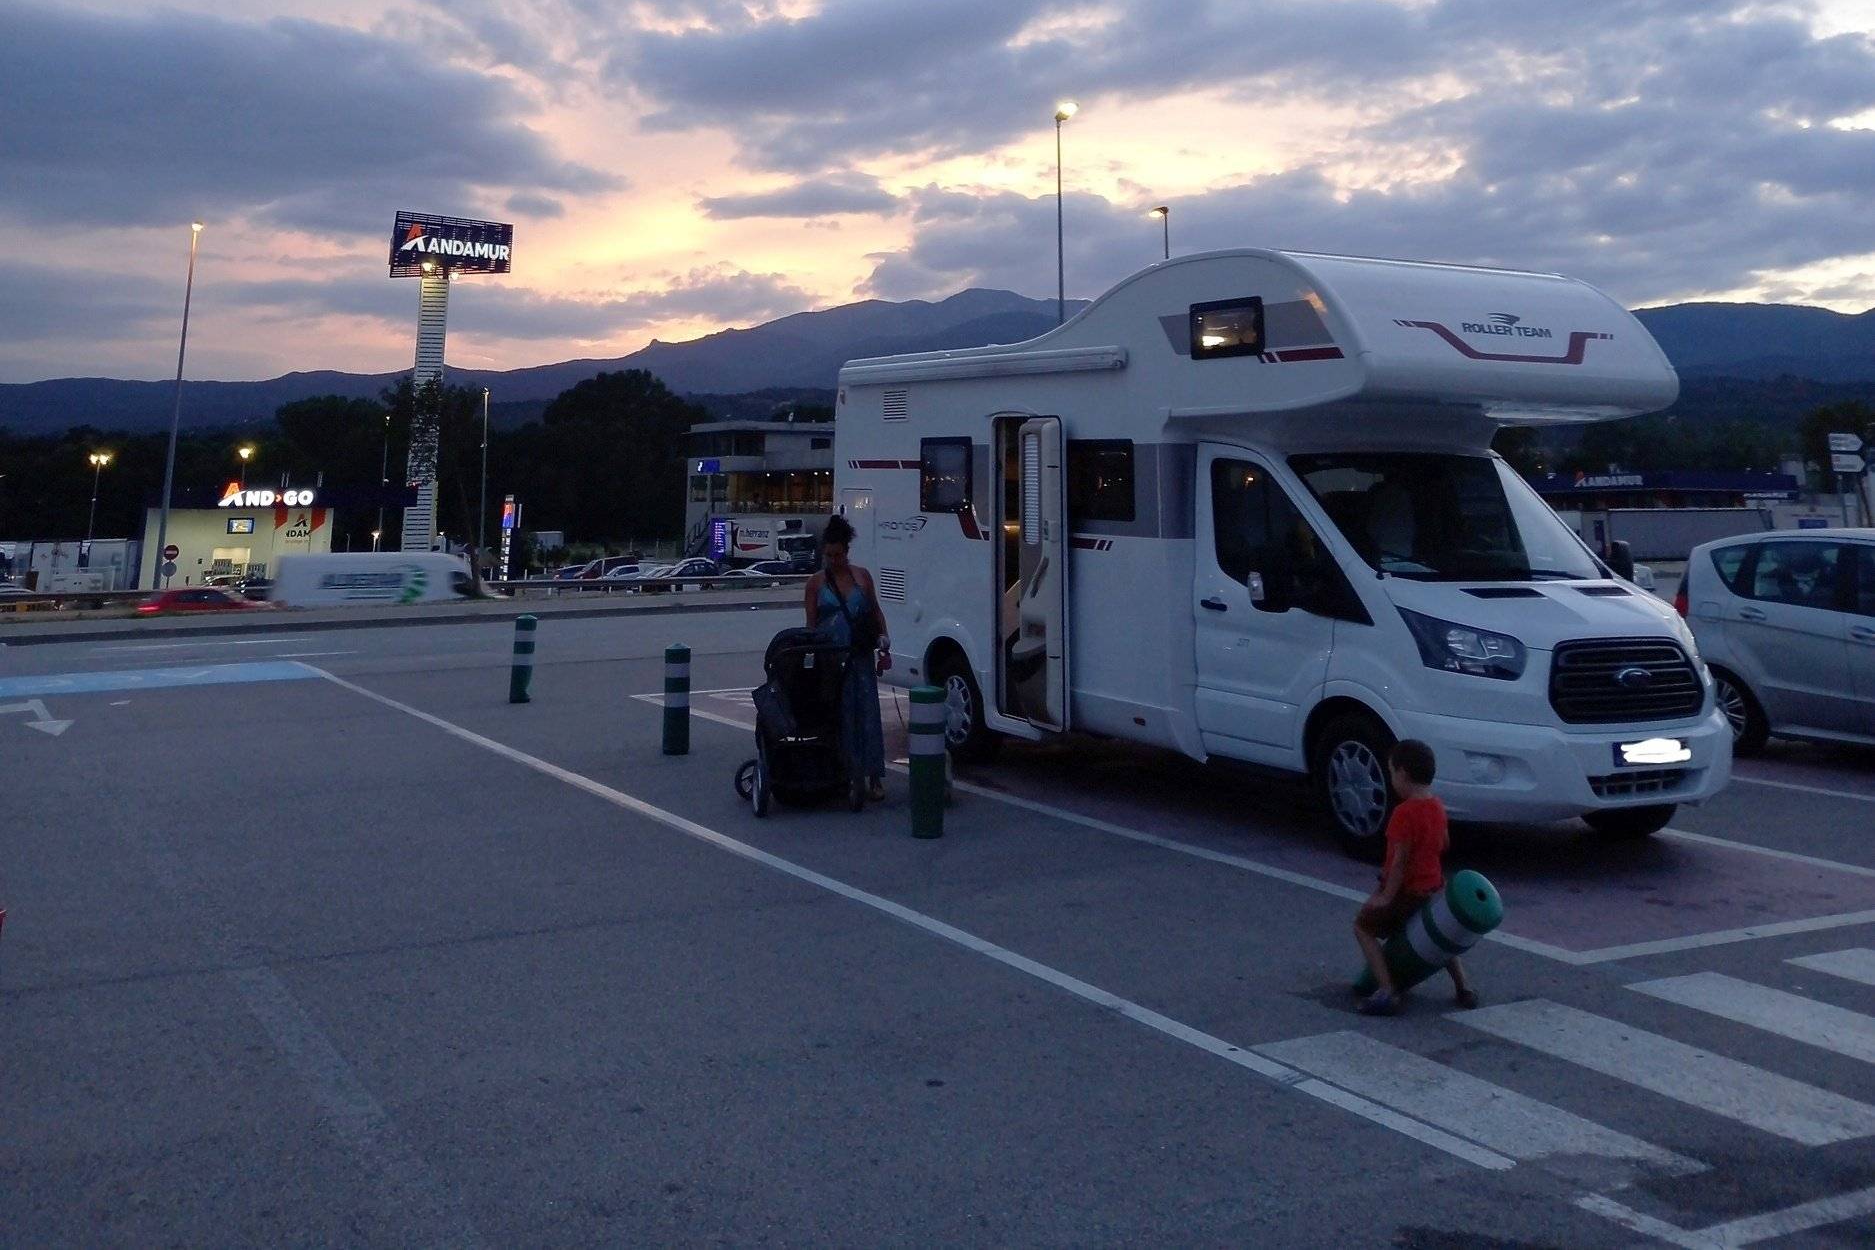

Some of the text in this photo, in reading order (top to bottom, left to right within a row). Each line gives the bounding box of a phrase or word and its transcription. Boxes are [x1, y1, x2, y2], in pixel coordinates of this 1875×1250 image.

[427, 237, 510, 261] ANDAMUR
[1462, 322, 1553, 338] ROLLER TEAM
